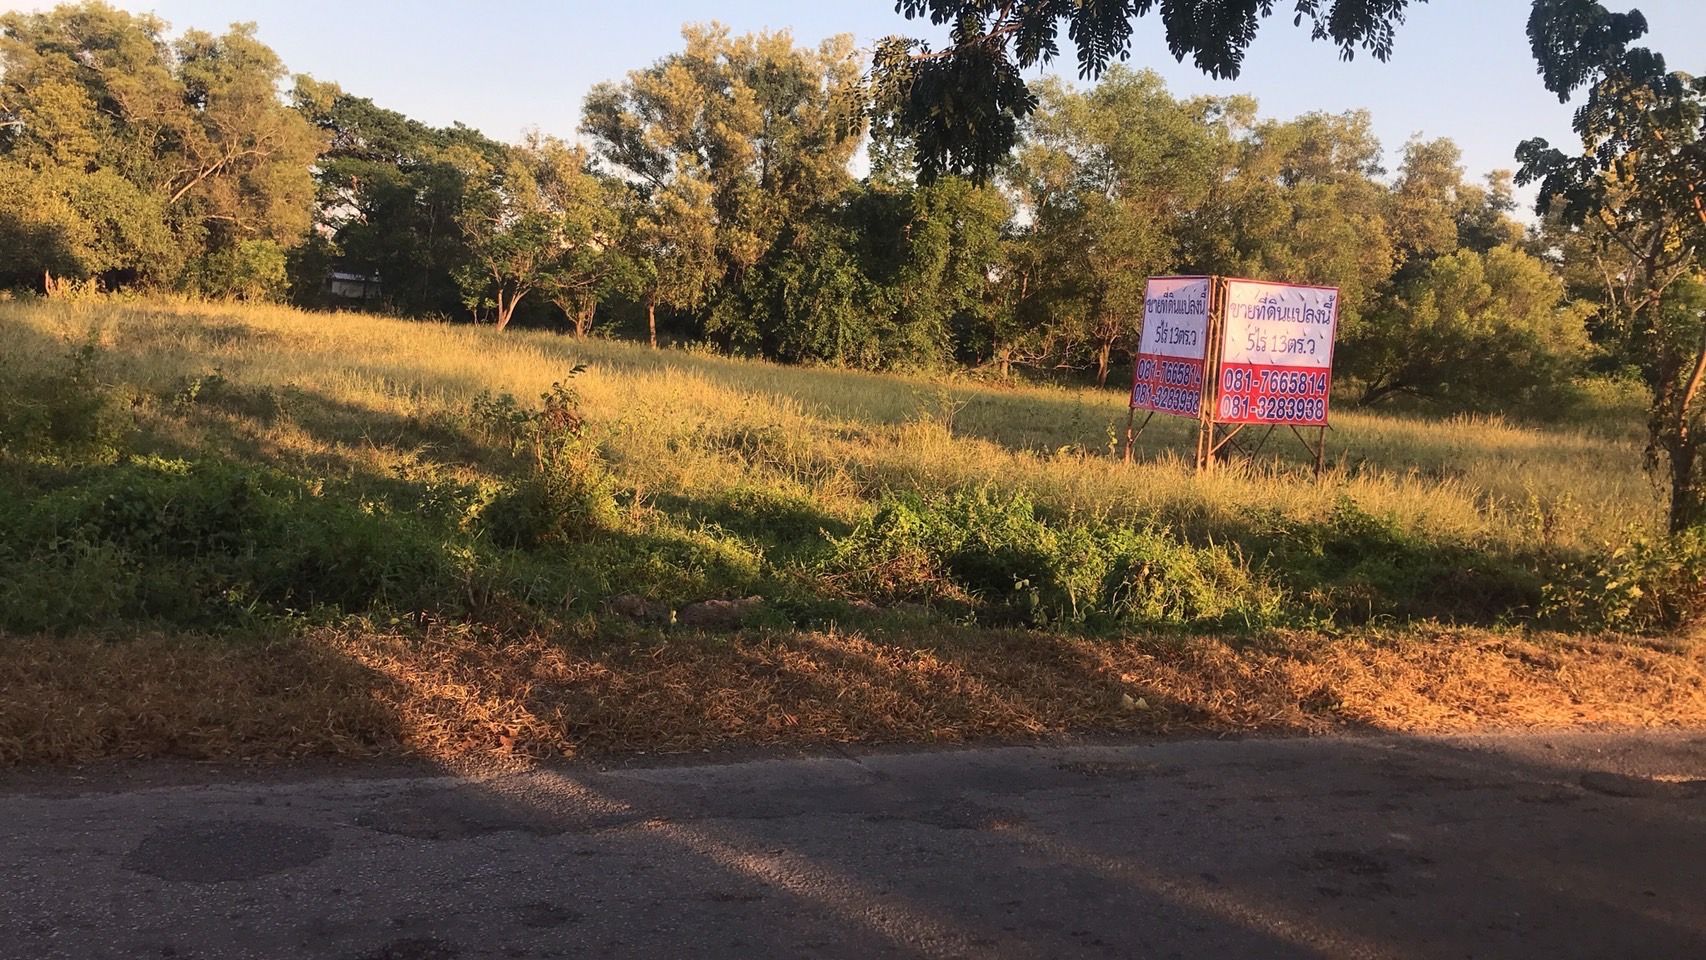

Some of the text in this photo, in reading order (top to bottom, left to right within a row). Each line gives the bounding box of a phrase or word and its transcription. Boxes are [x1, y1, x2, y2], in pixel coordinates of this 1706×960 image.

[1147, 285, 1207, 315] ขายที่ดินแปลงนี้
[1230, 294, 1335, 325] ขายที่ดินแปลงนี้
[1137, 358, 1201, 387] 081-7665814
[1223, 367, 1327, 396] 081-7665814
[1133, 383, 1200, 414] 081-3283938
[1220, 393, 1325, 420] 081-3283938
